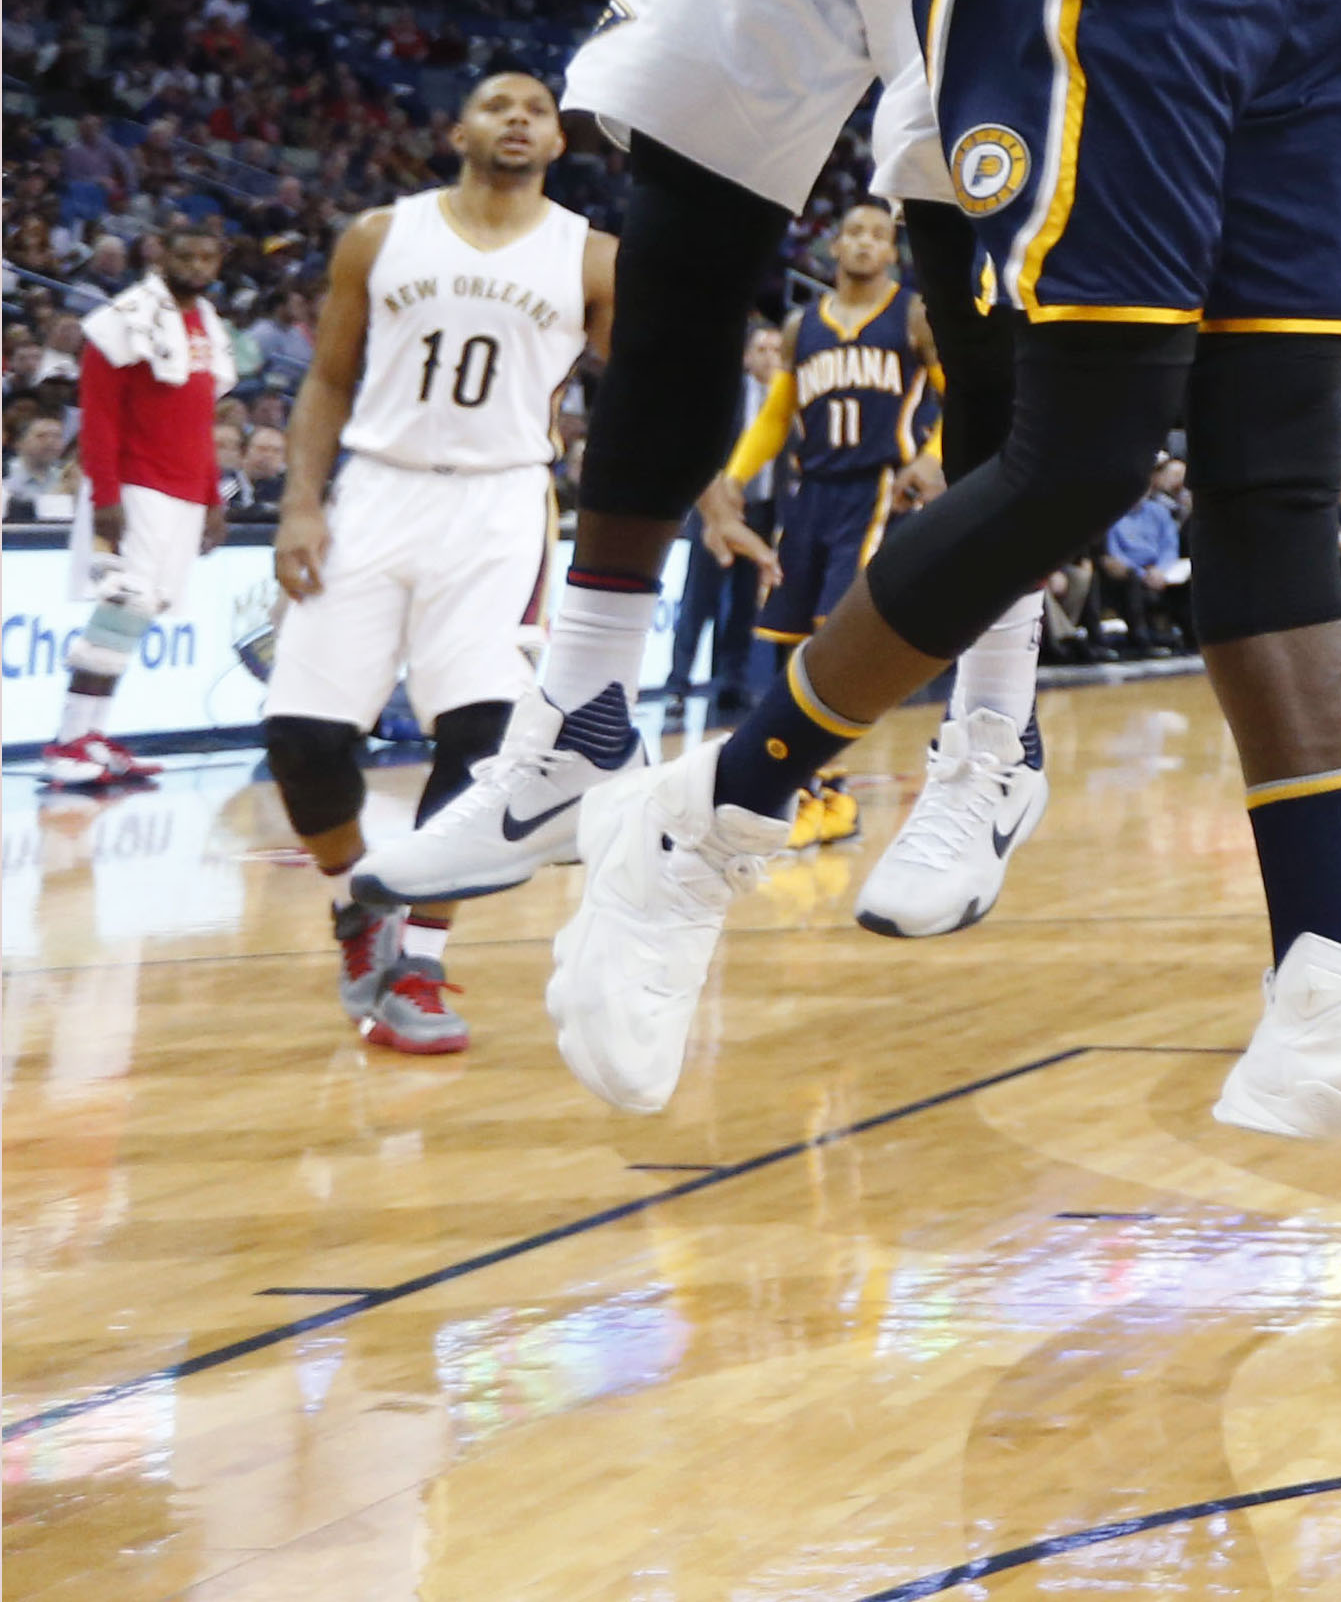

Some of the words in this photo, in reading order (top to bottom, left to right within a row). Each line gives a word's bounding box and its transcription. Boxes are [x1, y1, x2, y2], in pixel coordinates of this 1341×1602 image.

[384, 276, 440, 314] NEW
[453, 274, 558, 331] ORLEANS
[418, 327, 500, 408] 10
[797, 345, 902, 397] INDIANA
[827, 398, 860, 447] 11
[2, 613, 195, 679] Chon
